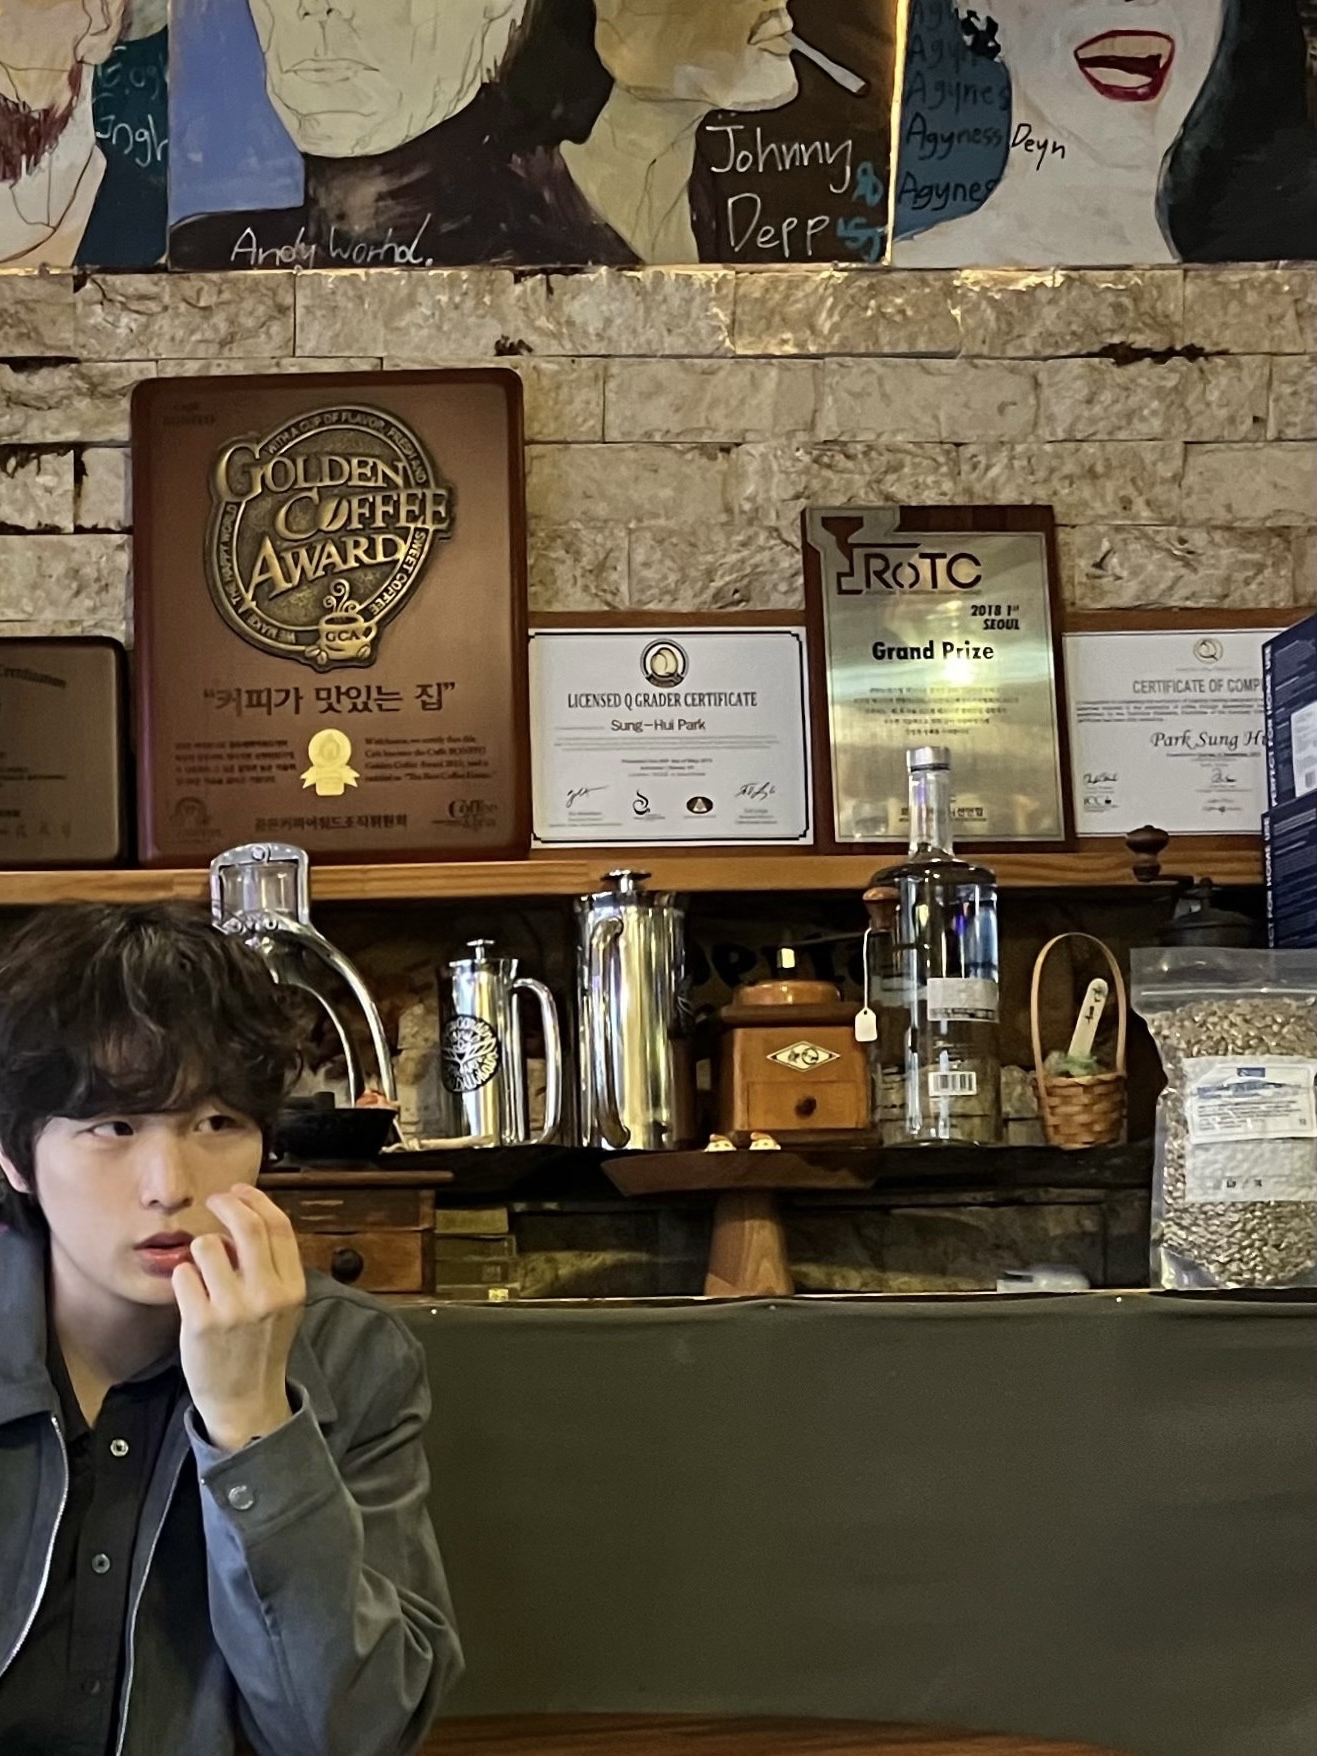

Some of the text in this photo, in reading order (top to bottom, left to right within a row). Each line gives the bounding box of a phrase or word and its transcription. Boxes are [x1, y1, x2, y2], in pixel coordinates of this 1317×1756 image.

[906, 112, 1066, 171] Agyness Deyn
[705, 125, 852, 193] Johnny
[727, 192, 830, 258] Depp
[230, 226, 316, 269] Andy
[215, 442, 408, 503] GOLDEN
[275, 486, 451, 541] COFFEE
[239, 533, 410, 613] AWARD
[367, 531, 427, 615] SWEET COFFEE
[971, 604, 1002, 617] 2018
[982, 618, 1021, 630] SEOUL
[325, 630, 361, 642] GCA
[872, 640, 995, 660] Grand Prize
[1264, 644, 1272, 670] USE
[314, 684, 404, 715] 맛있는
[1133, 678, 1206, 694] CERTIFICATE
[1208, 678, 1223, 693] OF
[567, 691, 758, 711] LICENSED Q GRADER CERTIFICATE
[677, 718, 707, 731] Park
[1150, 729, 1195, 750] Park
[1194, 731, 1239, 751] Sung
